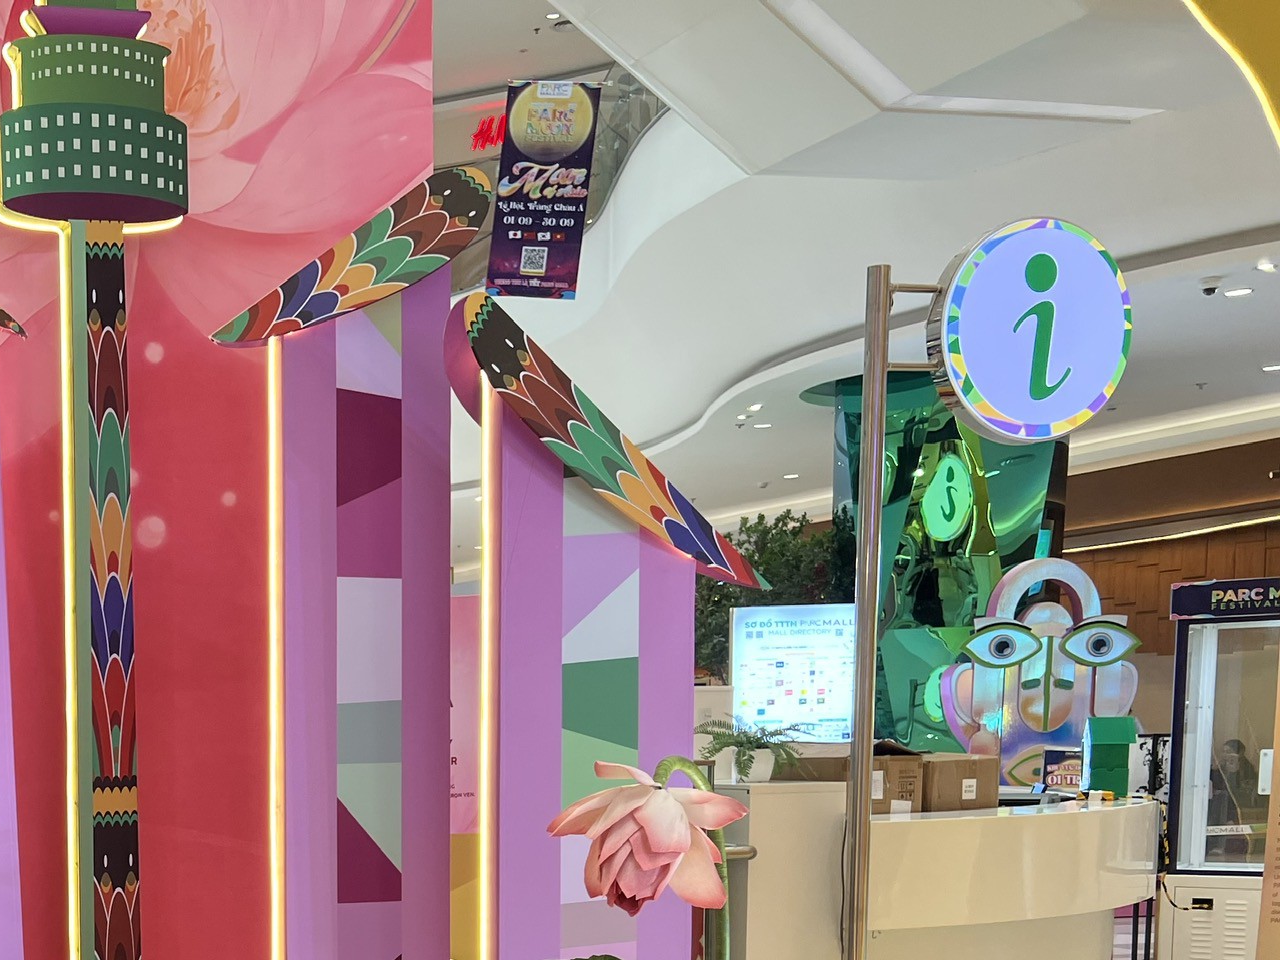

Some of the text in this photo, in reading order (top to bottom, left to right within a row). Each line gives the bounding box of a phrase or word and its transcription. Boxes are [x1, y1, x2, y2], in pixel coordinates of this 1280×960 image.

[1211, 587, 1264, 603] PARC
[1211, 600, 1280, 610] FESTIVAL
[790, 628, 832, 636] DIRECTORY
